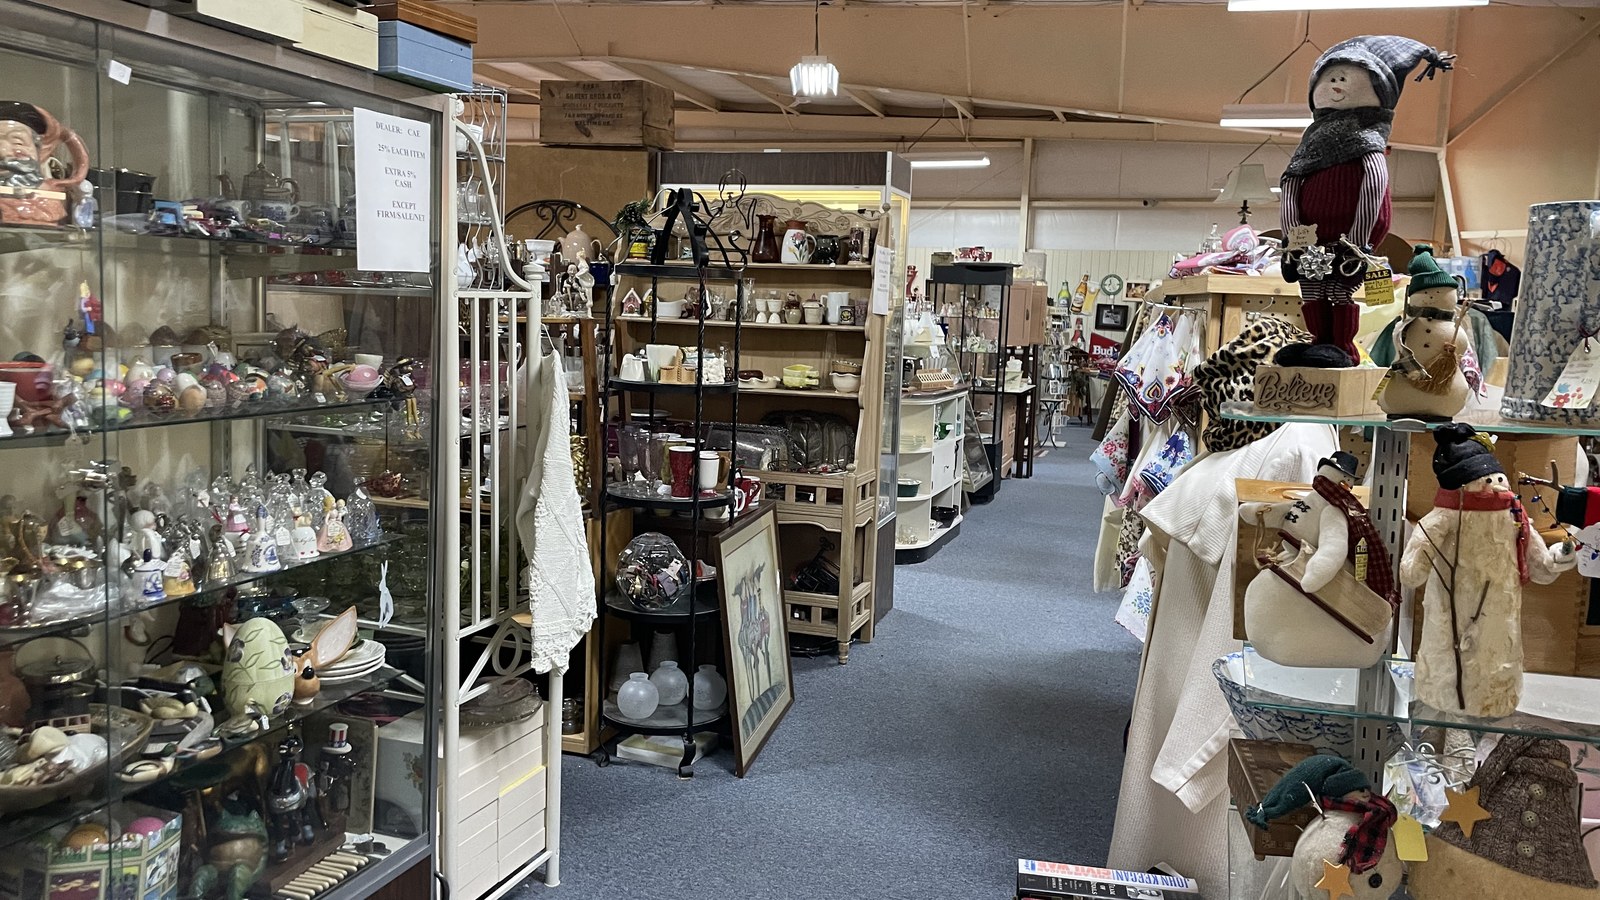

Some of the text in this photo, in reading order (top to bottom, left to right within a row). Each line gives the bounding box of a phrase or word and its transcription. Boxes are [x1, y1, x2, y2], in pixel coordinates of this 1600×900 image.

[376, 121, 421, 137] DEALER: CAE
[378, 143, 426, 159] 25% EACH ITEM
[384, 166, 417, 179] EXTRA 5%
[394, 179, 412, 189] CASH
[392, 200, 416, 210] EXCEPT
[1365, 270, 1390, 280] SALE
[1093, 345, 1114, 356] Bud
[1258, 371, 1335, 406] Believe
[1114, 869, 1190, 889] JOHN KEEGAN
